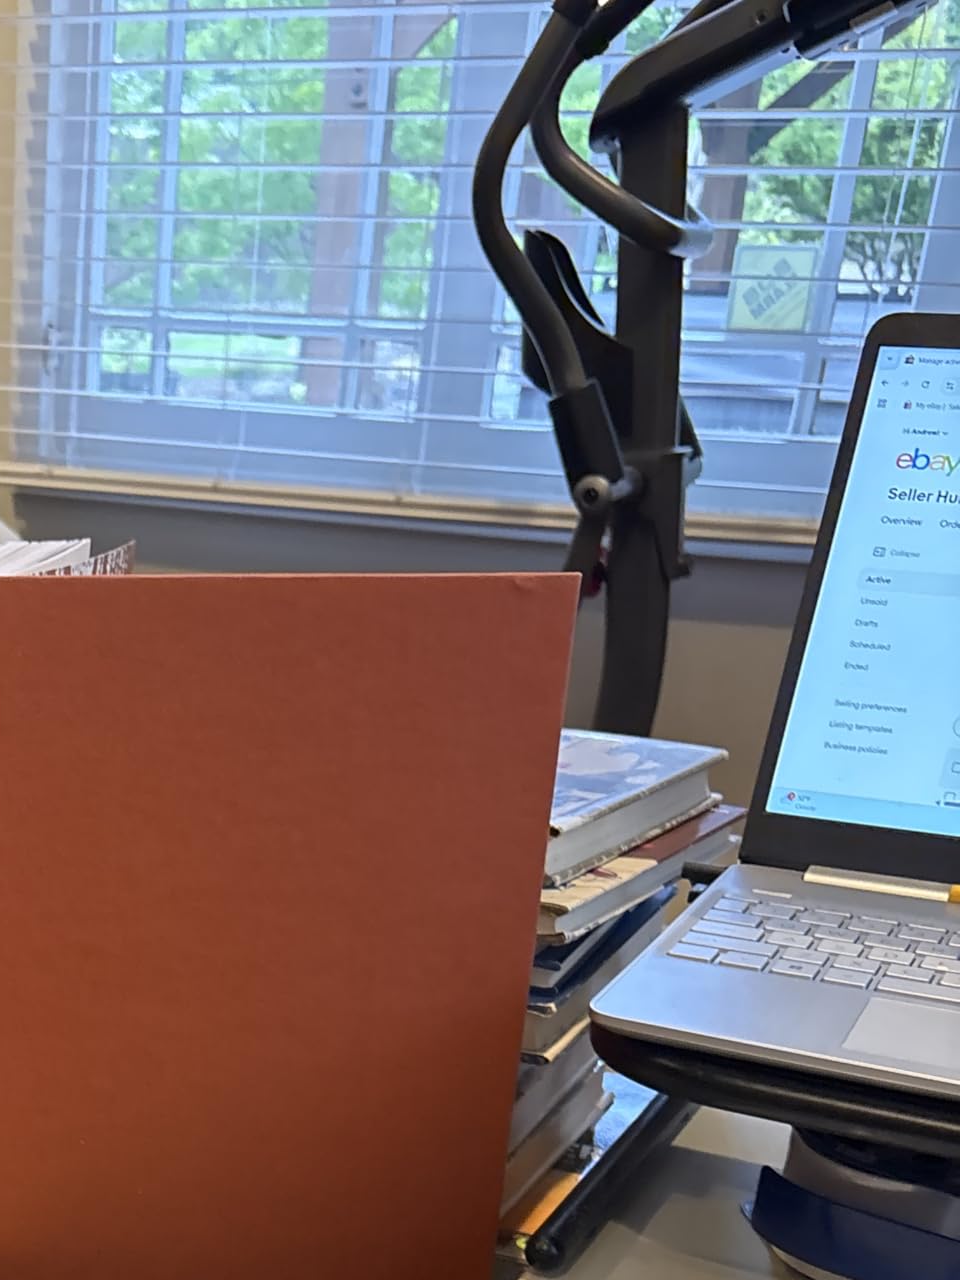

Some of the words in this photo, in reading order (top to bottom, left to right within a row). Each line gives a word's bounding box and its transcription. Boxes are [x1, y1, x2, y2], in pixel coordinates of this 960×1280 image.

[896, 448, 960, 477] ebay
[888, 488, 933, 502] Seller
[936, 490, 960, 504] Hu
[880, 516, 922, 526] Overview
[865, 576, 891, 584] Active
[849, 640, 891, 651] Scheduled
